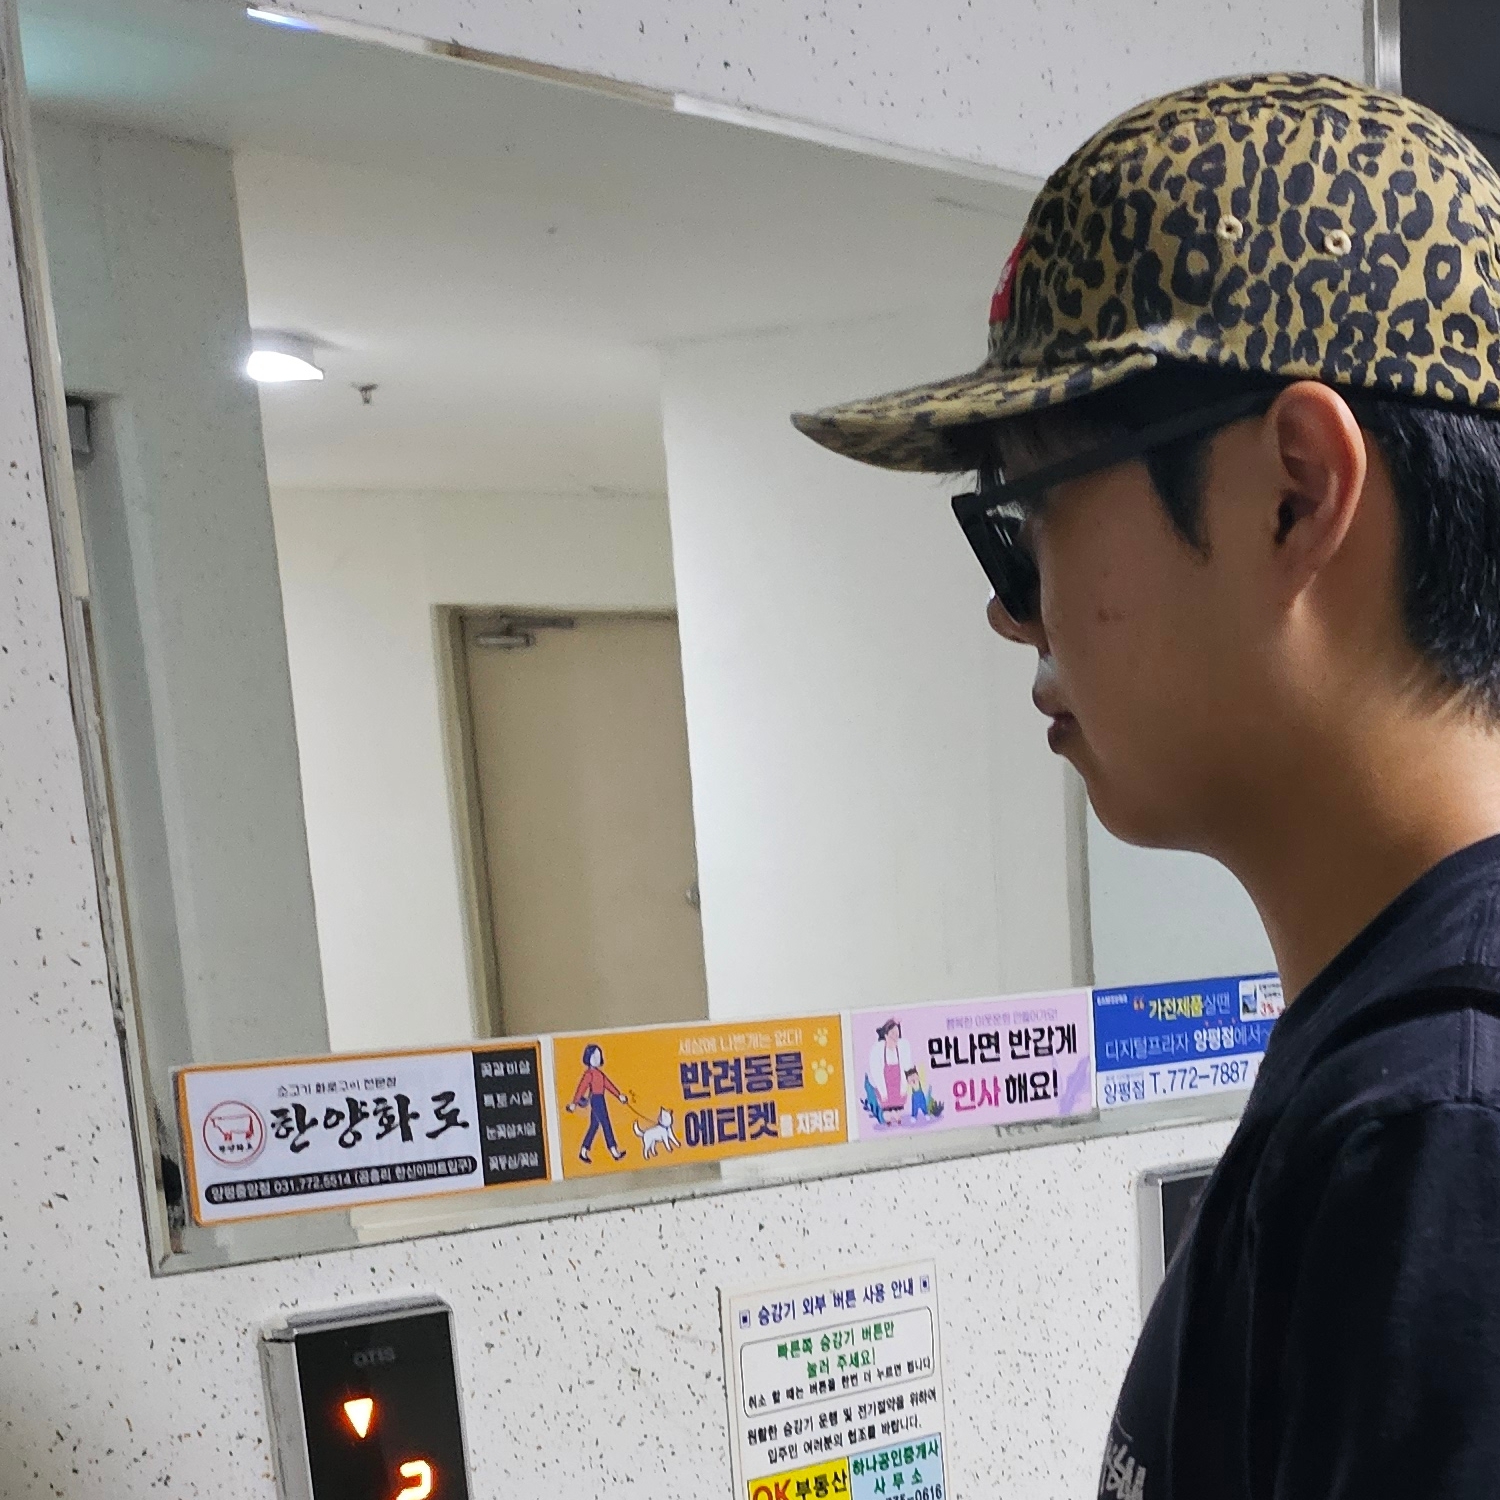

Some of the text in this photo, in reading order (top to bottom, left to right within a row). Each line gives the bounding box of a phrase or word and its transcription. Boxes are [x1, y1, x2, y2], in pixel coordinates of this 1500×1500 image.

[928, 1023, 1078, 1070] 만나면 반갑게
[1105, 1032, 1189, 1061] 디지털프라자
[680, 1051, 804, 1101] 반려동물
[952, 1068, 1060, 1113] 인사 해요!
[1149, 1060, 1249, 1096] T.772-7887
[758, 1277, 914, 1326] 승강기 외부 버튼 사용 안내
[819, 1328, 855, 1353] 승강기
[861, 1320, 895, 1342] 버튼만
[783, 1415, 814, 1438] 승강기
